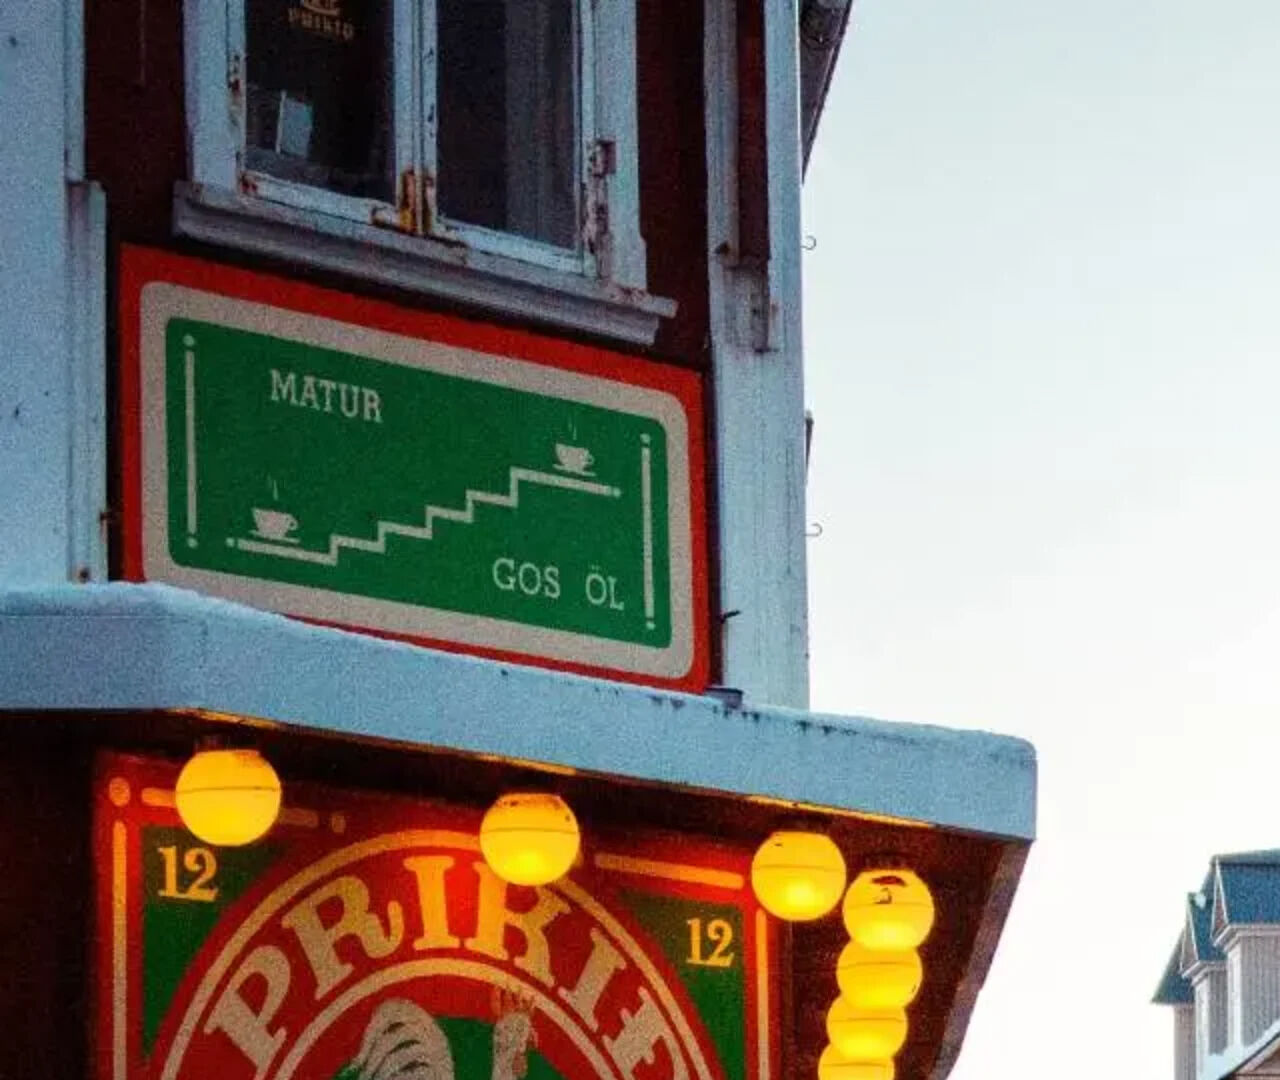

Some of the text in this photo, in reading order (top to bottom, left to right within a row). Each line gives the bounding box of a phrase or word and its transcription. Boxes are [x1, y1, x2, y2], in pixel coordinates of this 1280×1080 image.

[270, 368, 383, 423] MATUR
[493, 558, 624, 610] GOS ÖL
[157, 846, 220, 901] 12
[686, 917, 735, 967] 12
